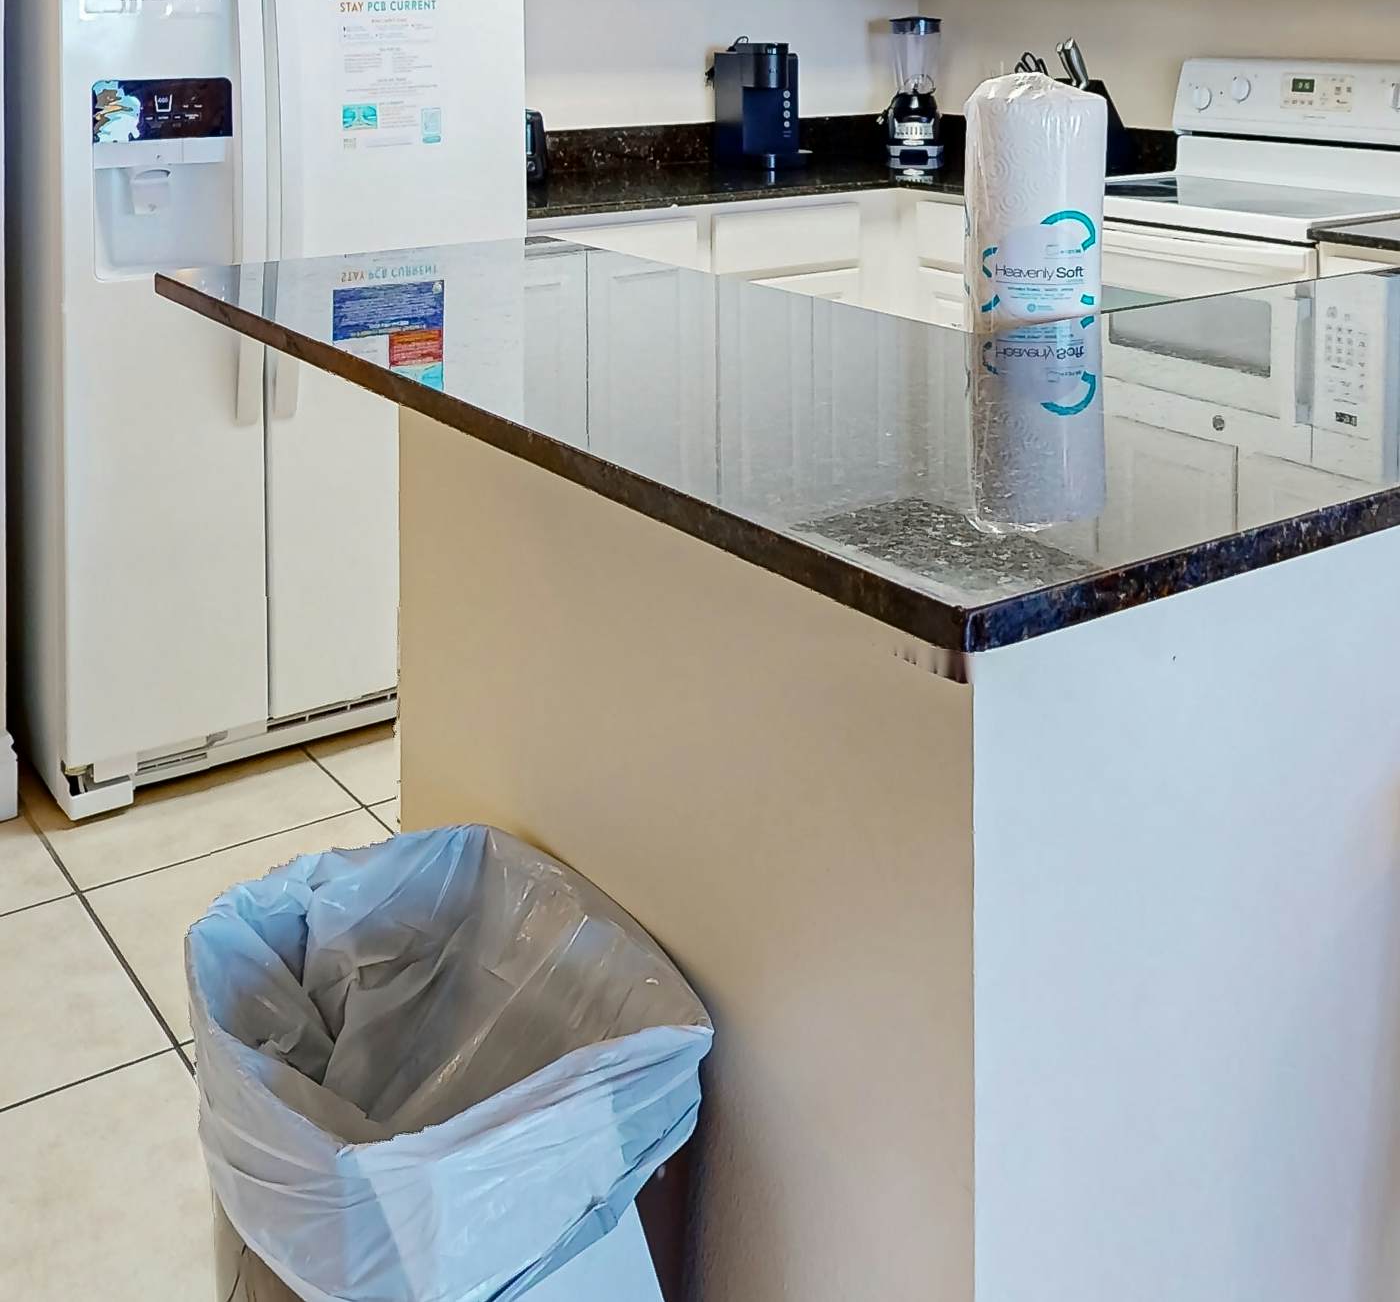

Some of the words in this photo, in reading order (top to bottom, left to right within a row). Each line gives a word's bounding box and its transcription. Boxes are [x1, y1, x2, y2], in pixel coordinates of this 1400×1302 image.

[340, 1, 364, 13] STAY
[367, 1, 387, 12] PCB
[389, 0, 437, 11] CURRENT
[995, 264, 1055, 281] Heavenly
[1056, 266, 1084, 279] Soft
